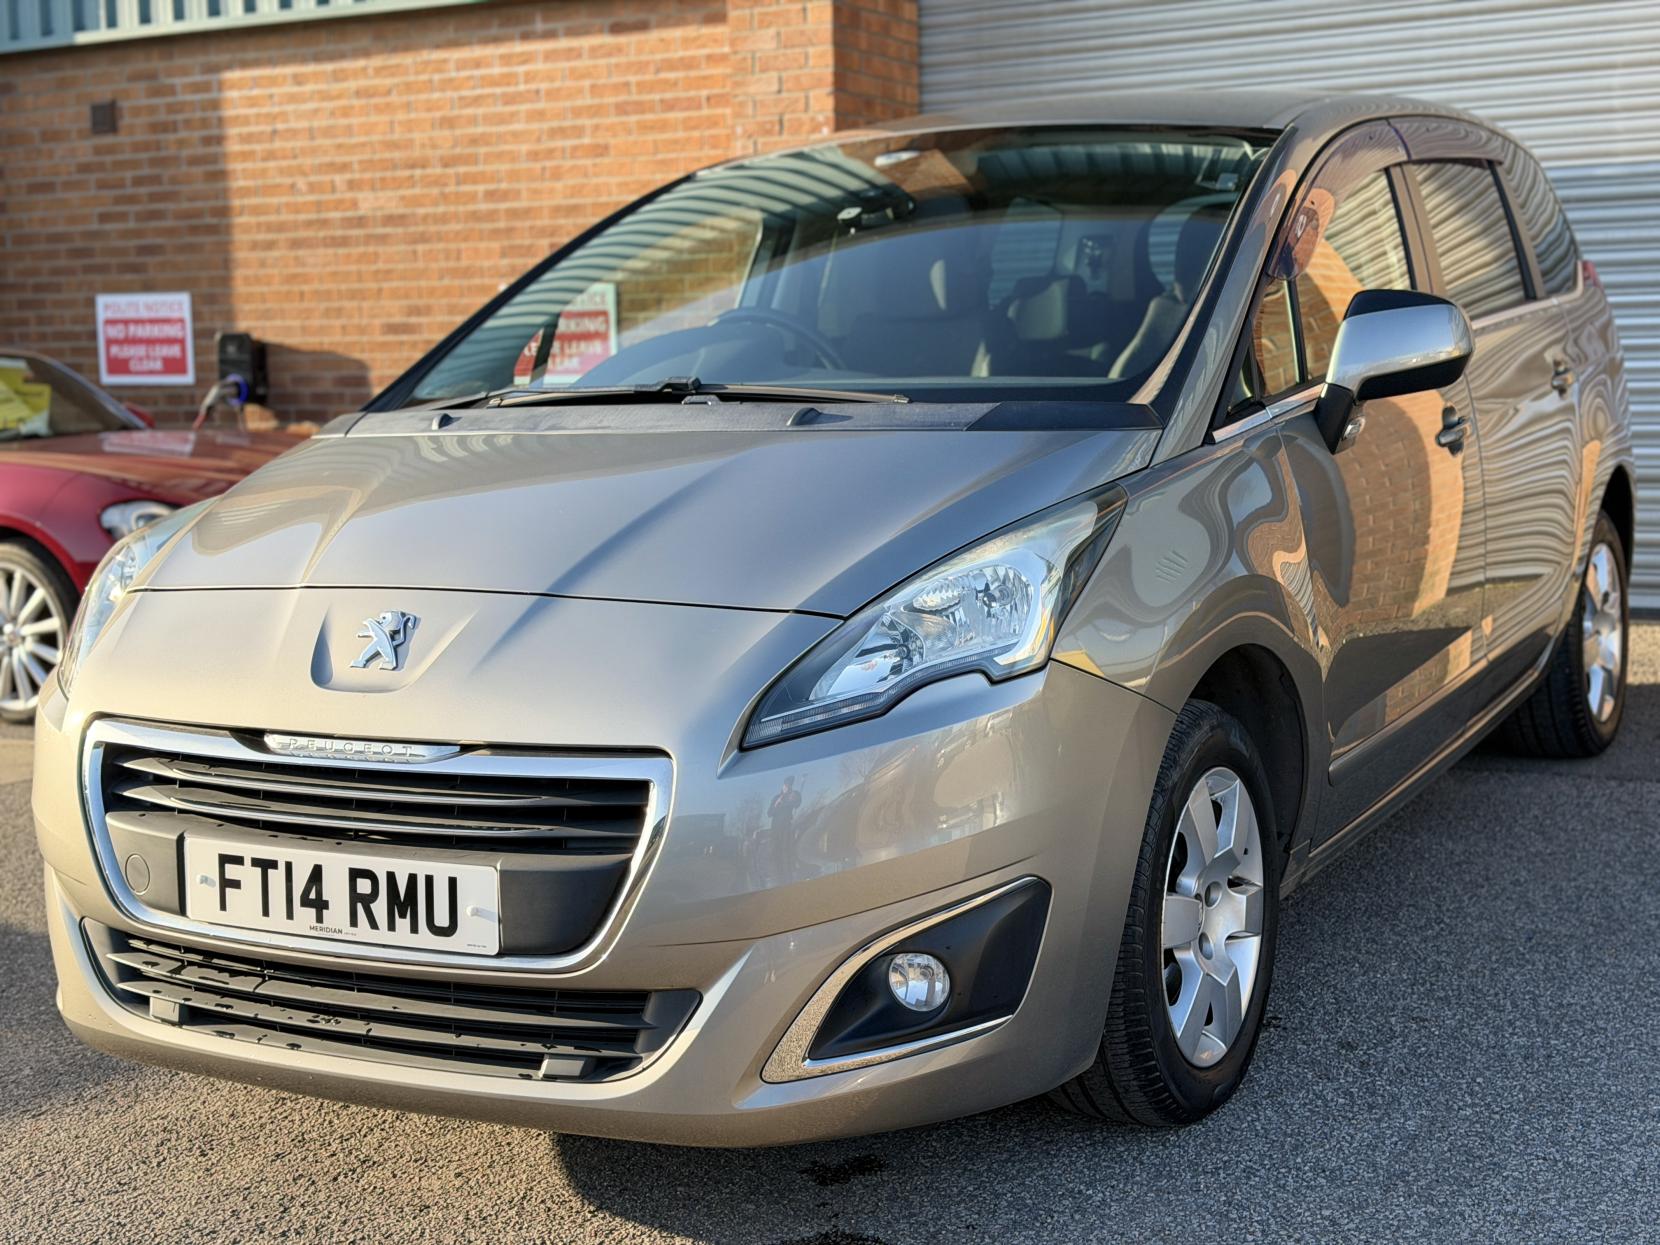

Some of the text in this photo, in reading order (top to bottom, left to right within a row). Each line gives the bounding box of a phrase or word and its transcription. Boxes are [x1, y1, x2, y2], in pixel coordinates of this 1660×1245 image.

[105, 321, 184, 339] NO PARKING
[109, 343, 182, 358] PLEASE LEAVE
[128, 358, 164, 372] CLEAR
[289, 737, 414, 757] PEUGEOT
[217, 852, 459, 938] FT14 RMU
[309, 924, 343, 935] MERIDIAN
